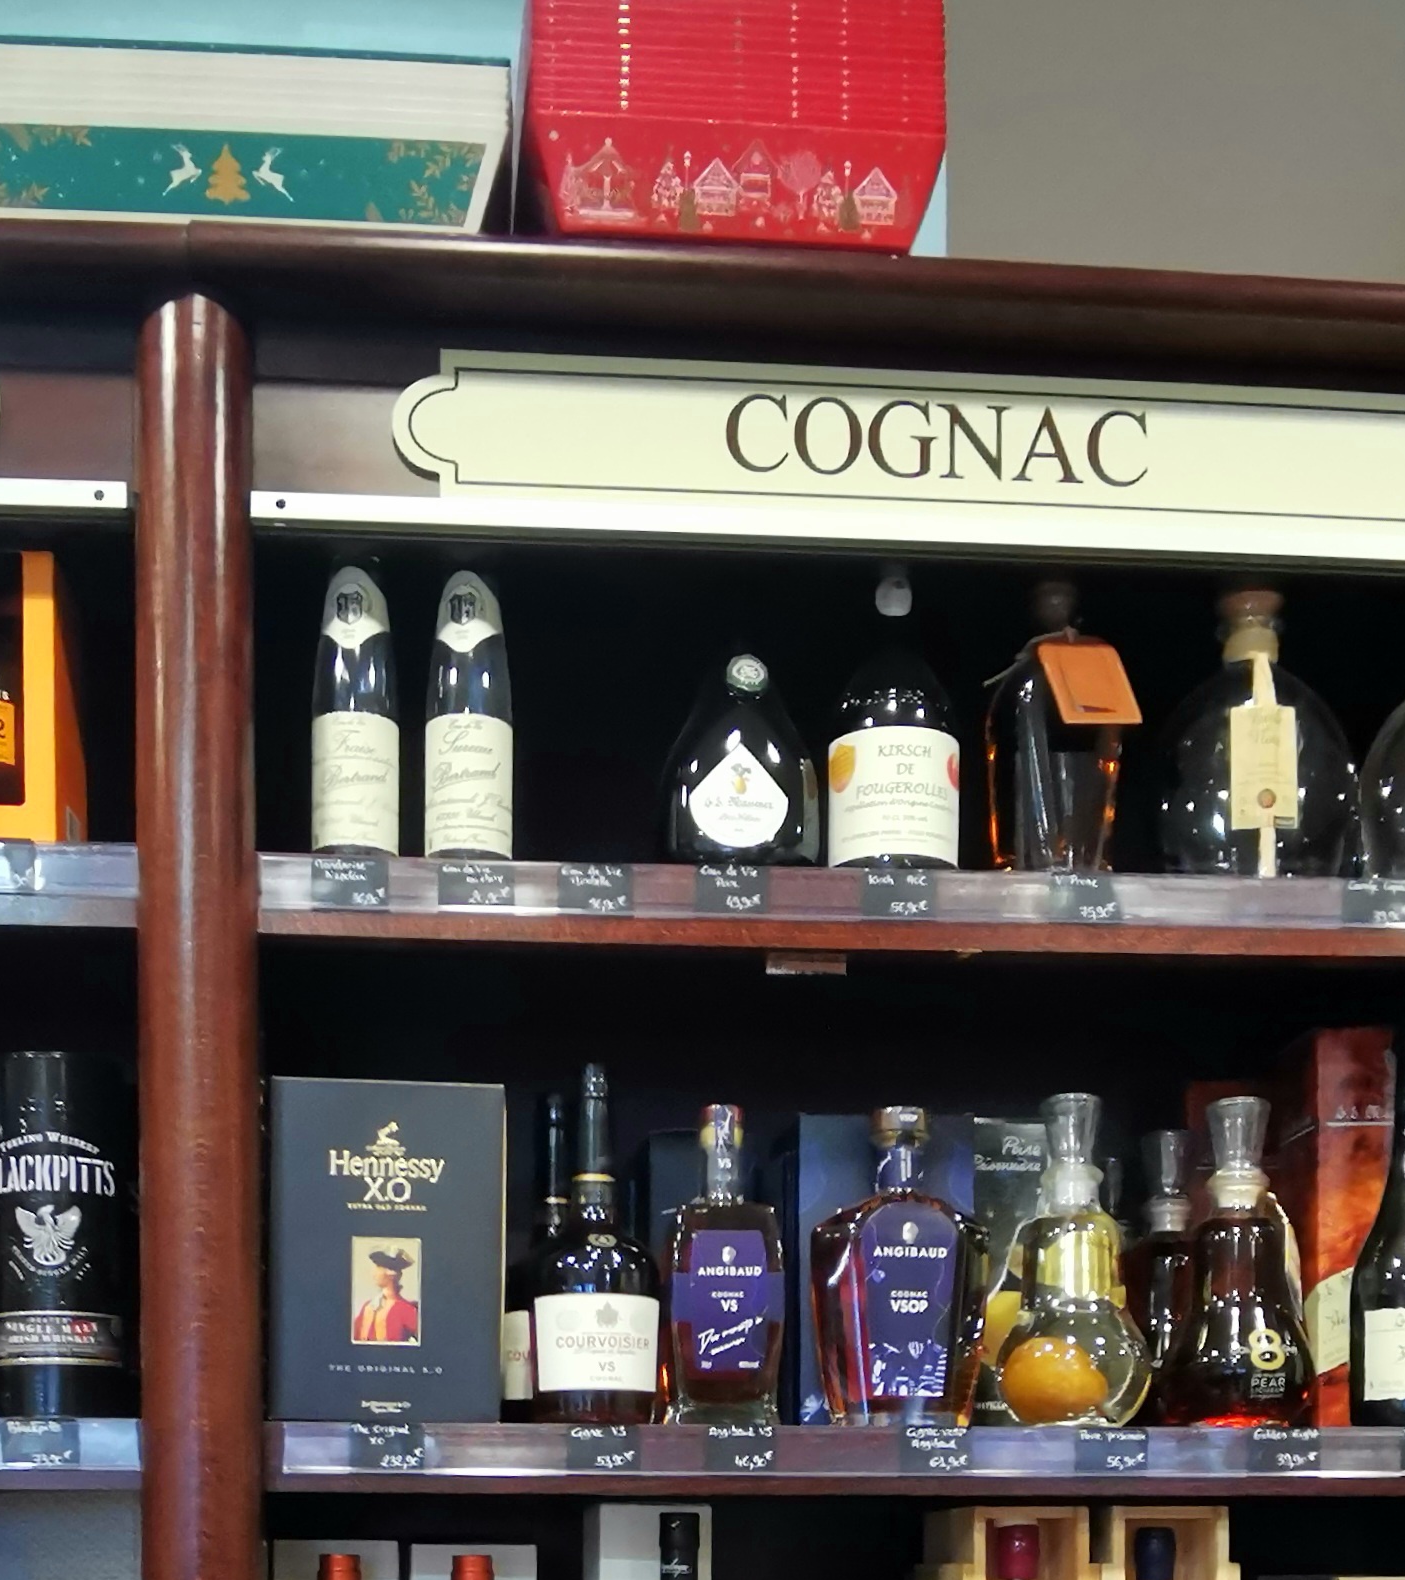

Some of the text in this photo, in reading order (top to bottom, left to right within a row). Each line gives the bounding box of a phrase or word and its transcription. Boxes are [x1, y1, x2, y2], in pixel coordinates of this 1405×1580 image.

[724, 392, 1150, 488] COGNAC
[333, 730, 375, 756] Fraise
[877, 744, 932, 759] KIRSCH
[430, 763, 502, 790] Bertrand
[896, 762, 915, 776] DE
[855, 782, 948, 800] FOUGEROLLES
[328, 1149, 446, 1184] Hennessy
[873, 1245, 947, 1259] ANGIBAUD
[697, 1265, 762, 1277] ANGIBAUD
[721, 1300, 739, 1312] VS
[891, 1299, 928, 1314] VSOP
[555, 1334, 650, 1352] COURVOISIER
[1248, 1328, 1286, 1371] 8
[357, 1364, 416, 1374] ORIGINAL
[599, 1361, 616, 1373] VS
[1251, 1377, 1286, 1387] PEAR
